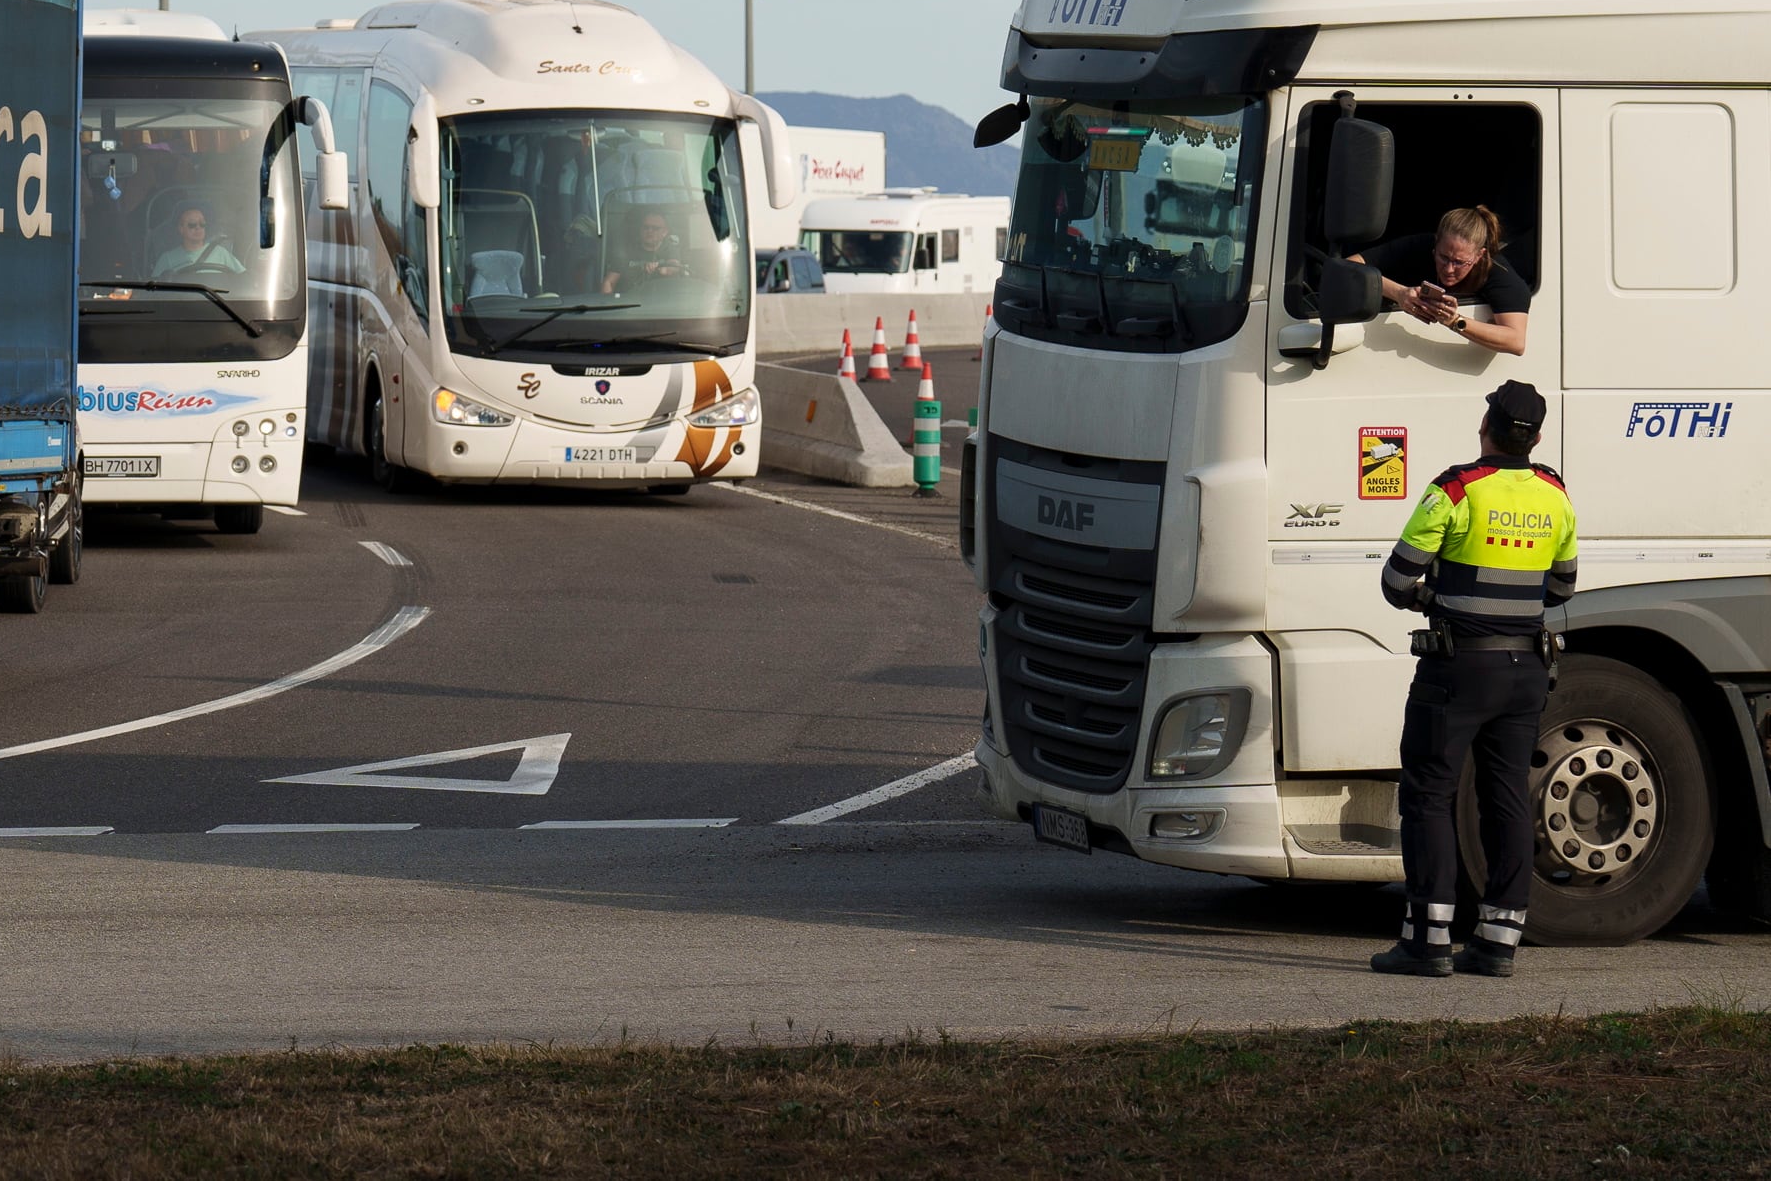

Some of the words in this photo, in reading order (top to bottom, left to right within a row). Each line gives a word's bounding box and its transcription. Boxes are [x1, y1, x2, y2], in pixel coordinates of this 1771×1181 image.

[537, 61, 592, 74] Santa
[584, 367, 620, 376] IRIZAR
[77, 384, 138, 411] bius
[136, 390, 213, 412] Reisen
[580, 397, 624, 405] SCANIA
[574, 450, 603, 460] 4221
[609, 450, 632, 460] DTH
[85, 460, 104, 472] BH
[107, 460, 134, 472] 7701
[1366, 478, 1400, 486] ANGLES
[1038, 495, 1095, 531] DAF
[1286, 503, 1345, 519] XF
[1488, 510, 1553, 529] POLICIA
